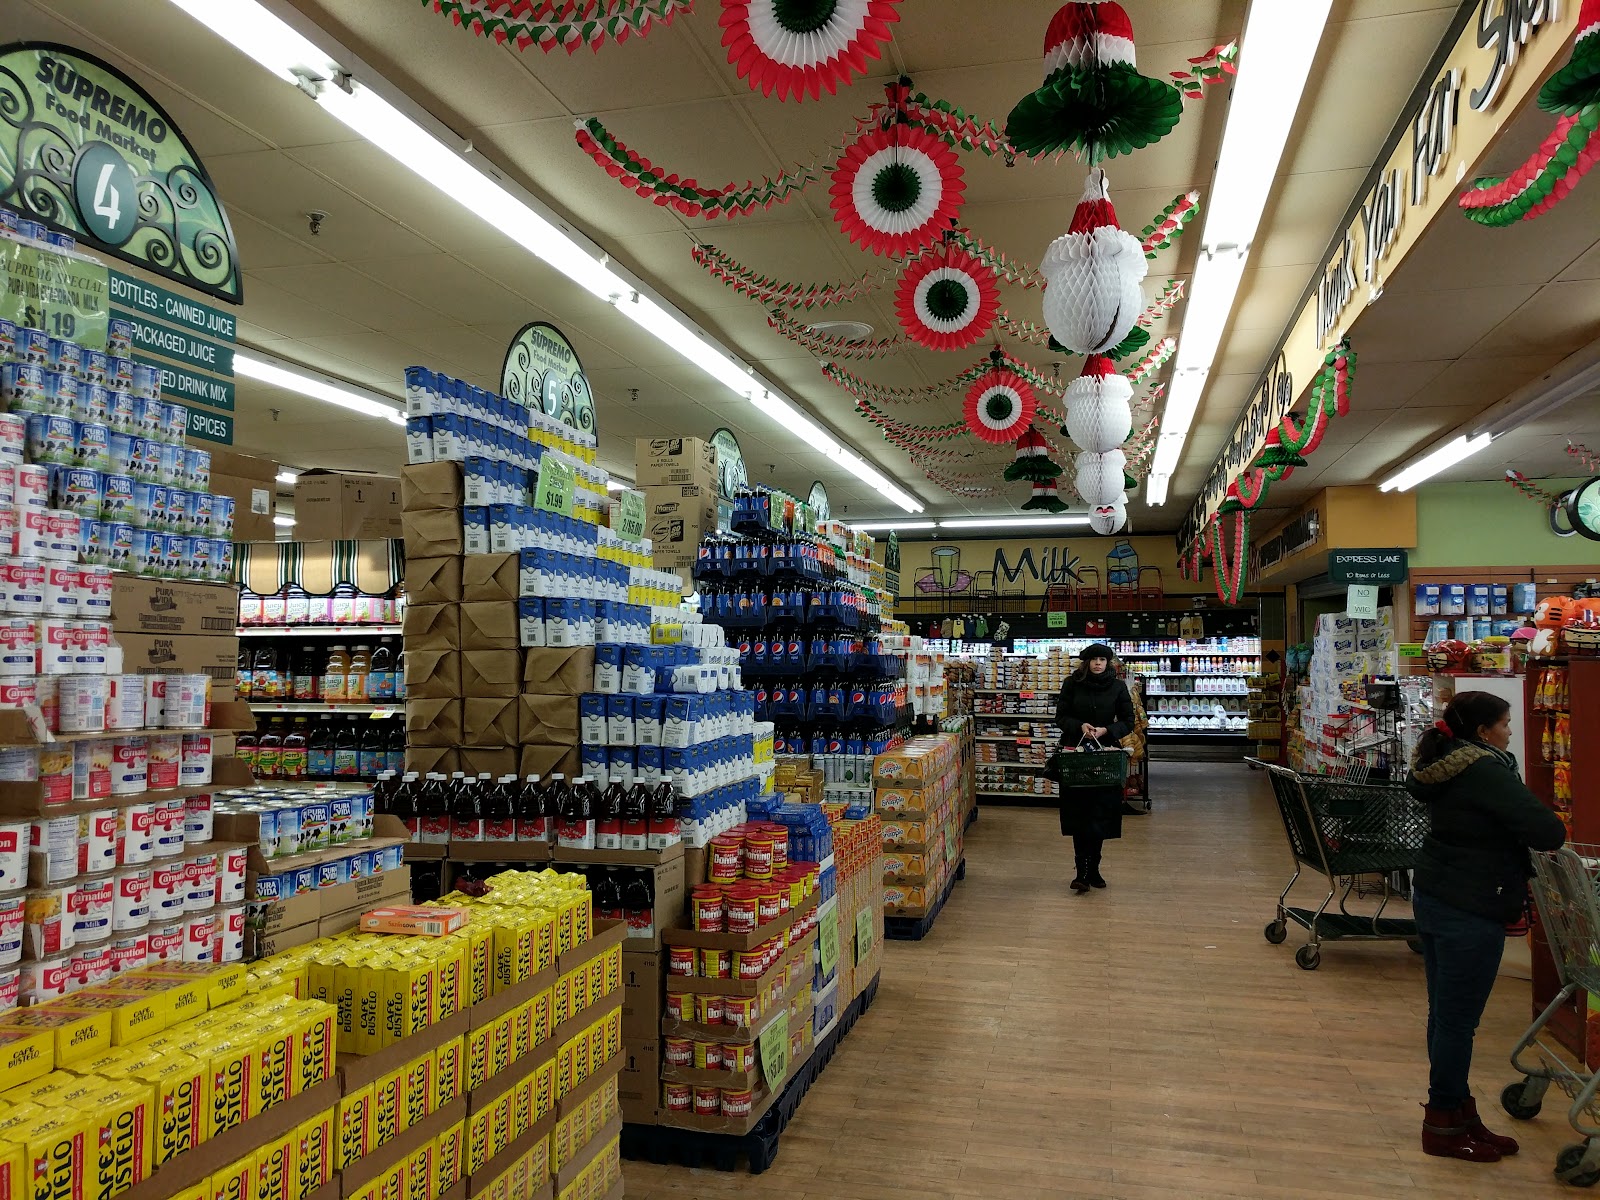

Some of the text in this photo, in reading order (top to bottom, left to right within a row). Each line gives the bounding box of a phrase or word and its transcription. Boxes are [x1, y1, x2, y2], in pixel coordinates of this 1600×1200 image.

[35, 56, 167, 144] SUPREMO
[45, 92, 157, 164] Food Market
[93, 163, 121, 230] 4
[57, 272, 104, 294] SPECIAL
[111, 276, 157, 309] BOTTLES
[166, 298, 205, 326] CANNED
[207, 316, 233, 337] JUICE
[24, 304, 76, 338] $1.19
[131, 321, 216, 364] PACKAGED JUICE
[531, 330, 571, 363] SUPREMO
[534, 350, 568, 375] Food Market
[178, 374, 209, 398] DRINK
[210, 384, 227, 403] MIX
[548, 380, 557, 416] 5
[53, 420, 72, 429] PURA
[193, 414, 227, 438] SPICES
[84, 427, 105, 437] PURA
[88, 433, 105, 443] VIDA
[71, 473, 93, 484] PURA
[74, 480, 94, 489] VIDA
[110, 478, 131, 490] PURA
[113, 486, 131, 495] VIDA
[546, 491, 563, 509] $1.99
[992, 546, 1085, 586] Milk
[1336, 555, 1401, 564] EXPRESS LANE
[1357, 589, 1370, 597] NO
[1354, 605, 1371, 614] WIC
[85, 655, 99, 663] Milk
[183, 743, 209, 751] nation
[132, 773, 144, 781] Milk
[307, 808, 326, 818] PURA
[310, 813, 327, 822] VIDA
[168, 836, 180, 844] Milk
[714, 853, 738, 865] Domin
[158, 872, 184, 886] Carnati
[256, 881, 275, 891] PURA
[126, 880, 150, 895] Carnat
[197, 889, 210, 898] Milk
[257, 887, 278, 896] VIDA
[700, 909, 722, 919] Domi
[84, 920, 101, 929] Milk
[503, 946, 512, 986] BUSTELO
[740, 963, 763, 974] Domi
[174, 994, 198, 1010] BUSTELO
[178, 990, 195, 1003] CAFE
[133, 1006, 151, 1019] CAFE
[336, 994, 345, 1026] CAFE
[344, 988, 353, 1034] BUSTELO
[360, 997, 369, 1029] CAFE
[368, 990, 377, 1036] BUSTELO
[386, 998, 395, 1031] CAFE
[393, 992, 403, 1038] BUSTELO
[129, 1010, 155, 1027] BUSTELO
[70, 1029, 100, 1047] BUSTELO
[75, 1024, 95, 1038] CAFE
[8, 1049, 41, 1069] BUSTELO
[13, 1044, 35, 1060] CAFE
[667, 1094, 692, 1106] Domi
[696, 1096, 720, 1108] Domi
